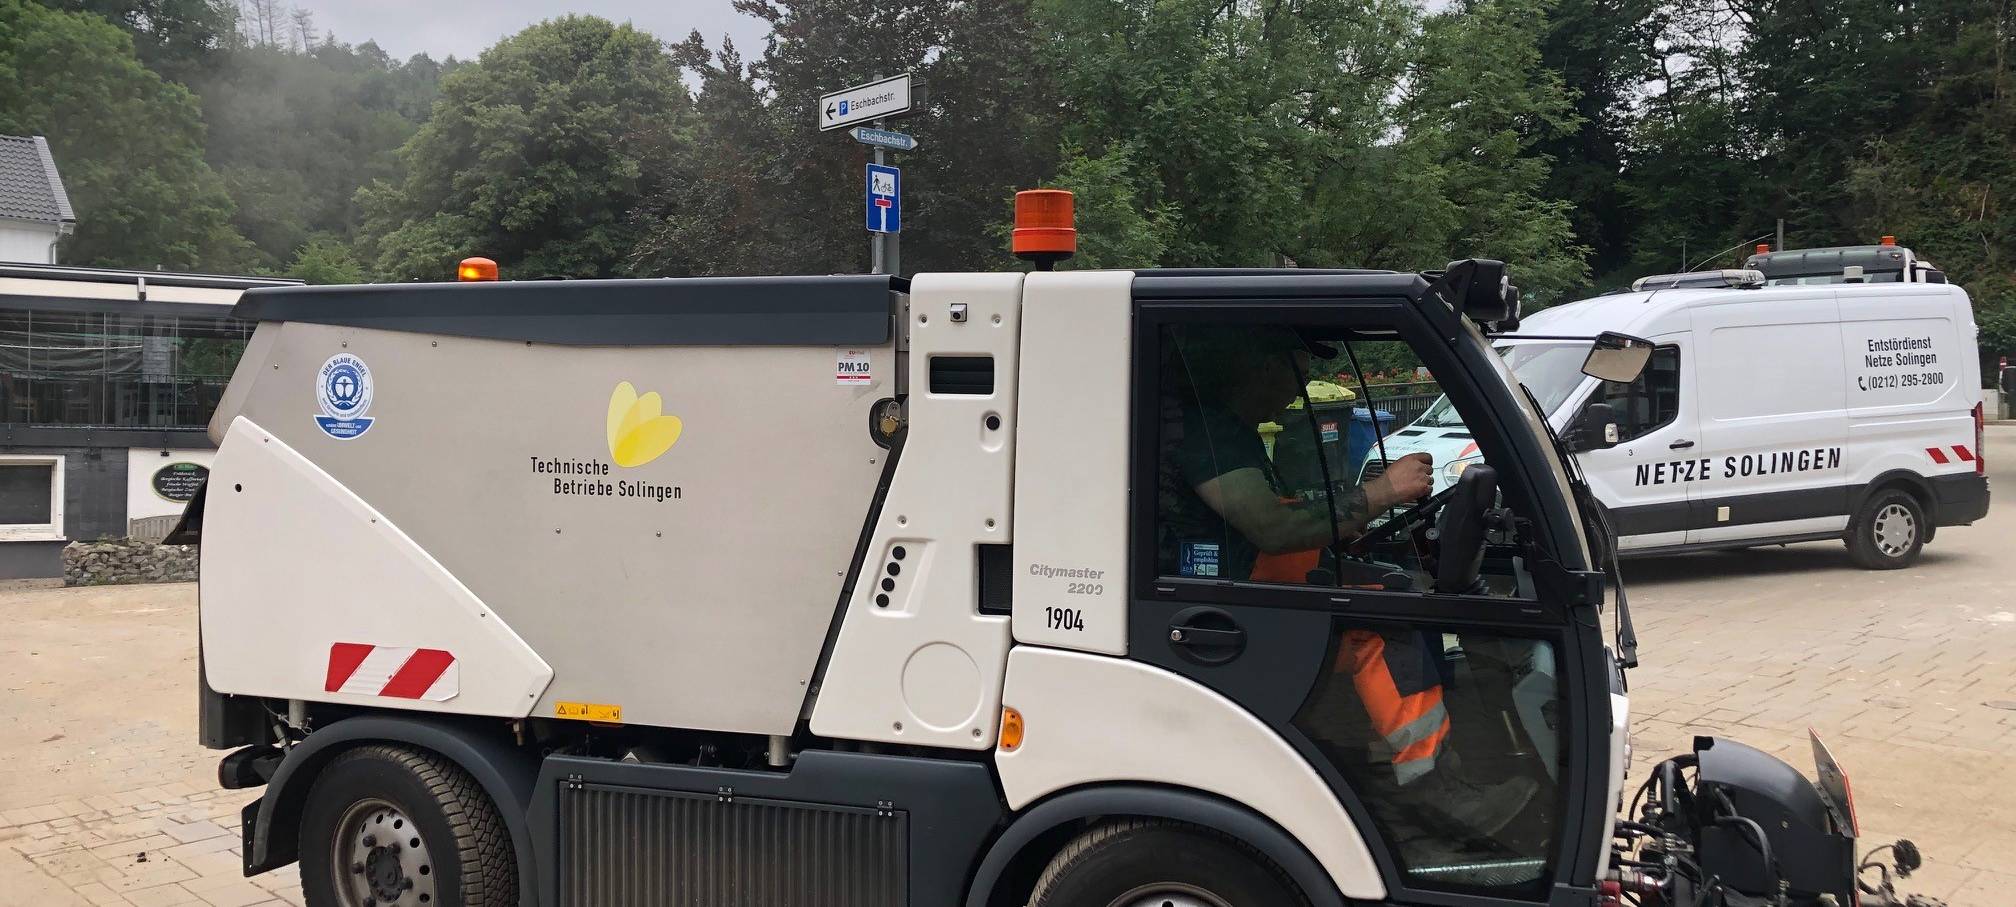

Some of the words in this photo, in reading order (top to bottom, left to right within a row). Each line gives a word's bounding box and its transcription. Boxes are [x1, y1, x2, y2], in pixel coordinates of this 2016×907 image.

[850, 91, 896, 111] Eschbachstr.
[860, 129, 909, 147] Eschbachstr.
[1867, 336, 1932, 352] Entstördienst
[322, 363, 334, 376] DER
[333, 357, 351, 365] BLAUE
[352, 358, 367, 377] ENGEL
[838, 362, 855, 372] PM
[856, 362, 870, 372] 10
[1865, 354, 1893, 368] Netze
[1895, 352, 1937, 367] Solingen
[1868, 374, 1899, 390] (0212)
[1901, 372, 1944, 387] 295-2800
[1628, 449, 1634, 457] 3
[530, 456, 609, 475] Technische
[1635, 458, 1711, 486] NETZE
[1724, 447, 1841, 478] SOLINGEN
[554, 478, 613, 496] Betriebe
[618, 480, 682, 502] Solingen
[1029, 563, 1104, 579] Citymaster
[1045, 606, 1084, 631] 1904
